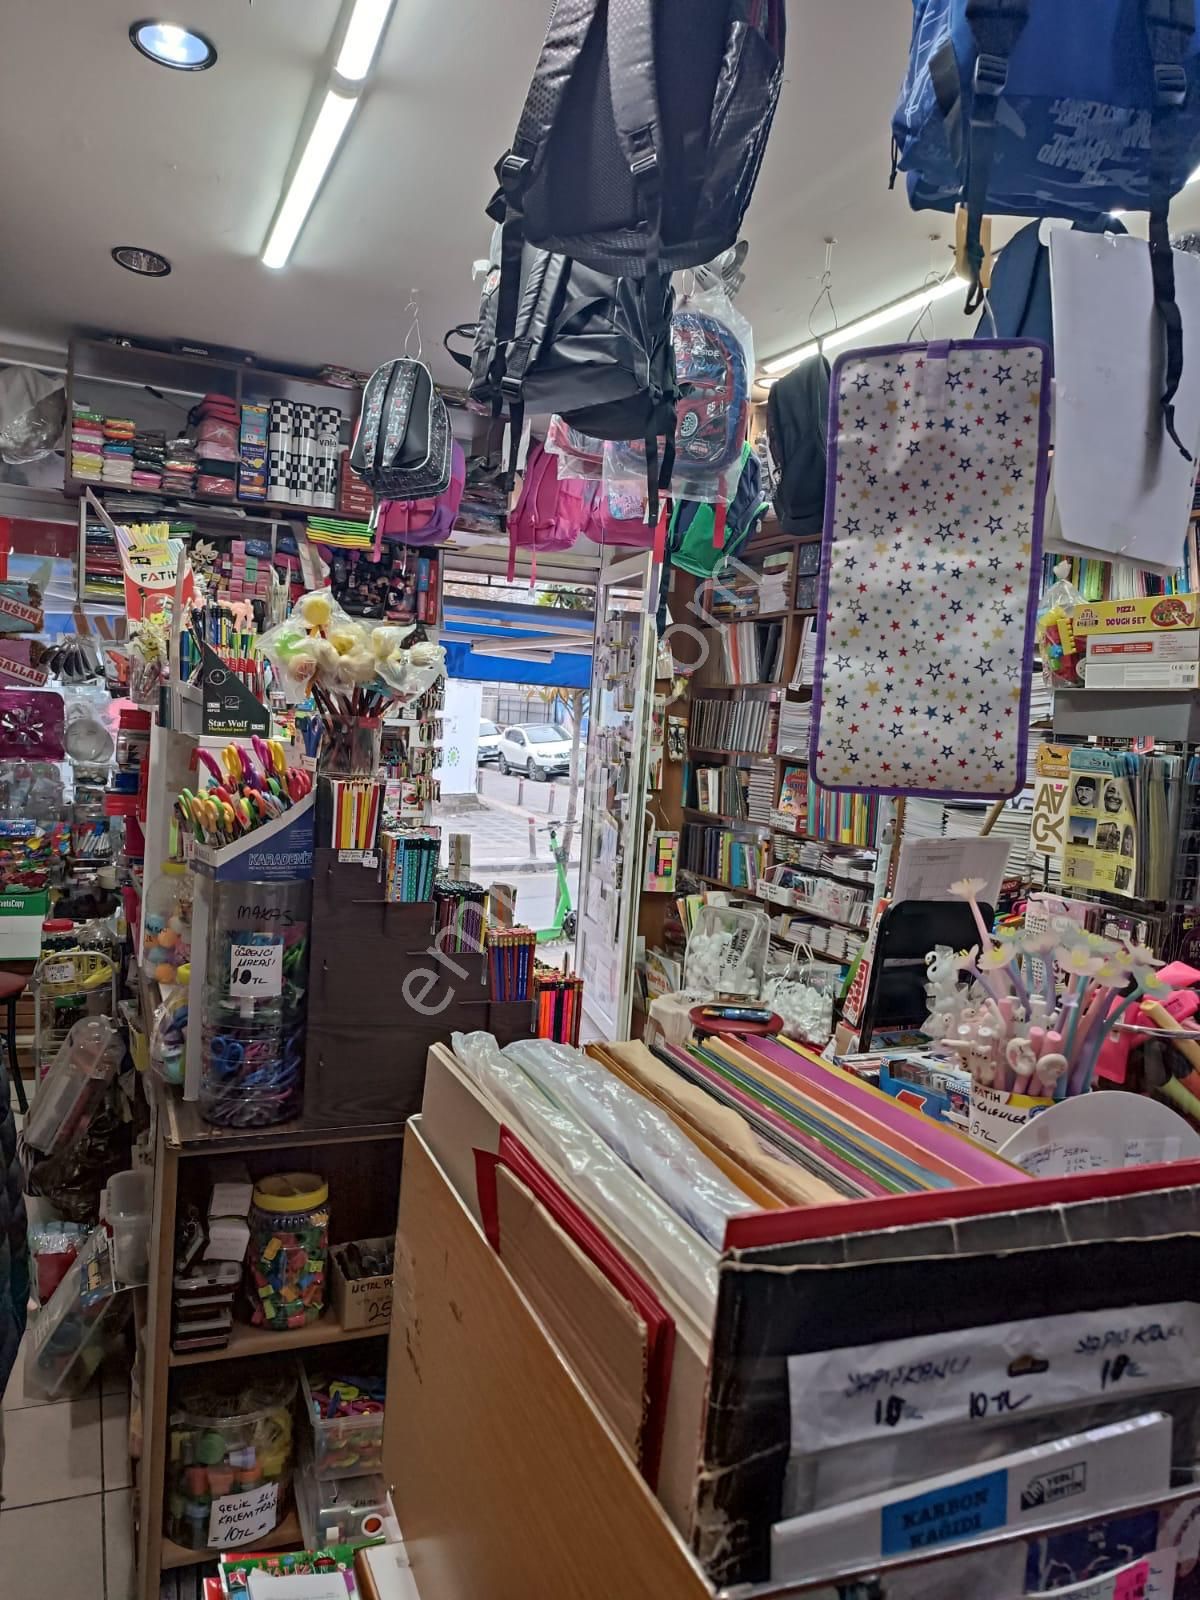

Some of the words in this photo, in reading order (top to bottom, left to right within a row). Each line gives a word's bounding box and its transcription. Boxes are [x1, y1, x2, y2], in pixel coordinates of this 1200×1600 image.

[1105, 617, 1130, 626] DOUGH
[1131, 616, 1147, 624] SET
[208, 719, 226, 728] Star
[227, 719, 248, 728] Wolf
[903, 1487, 989, 1530] KARBON
